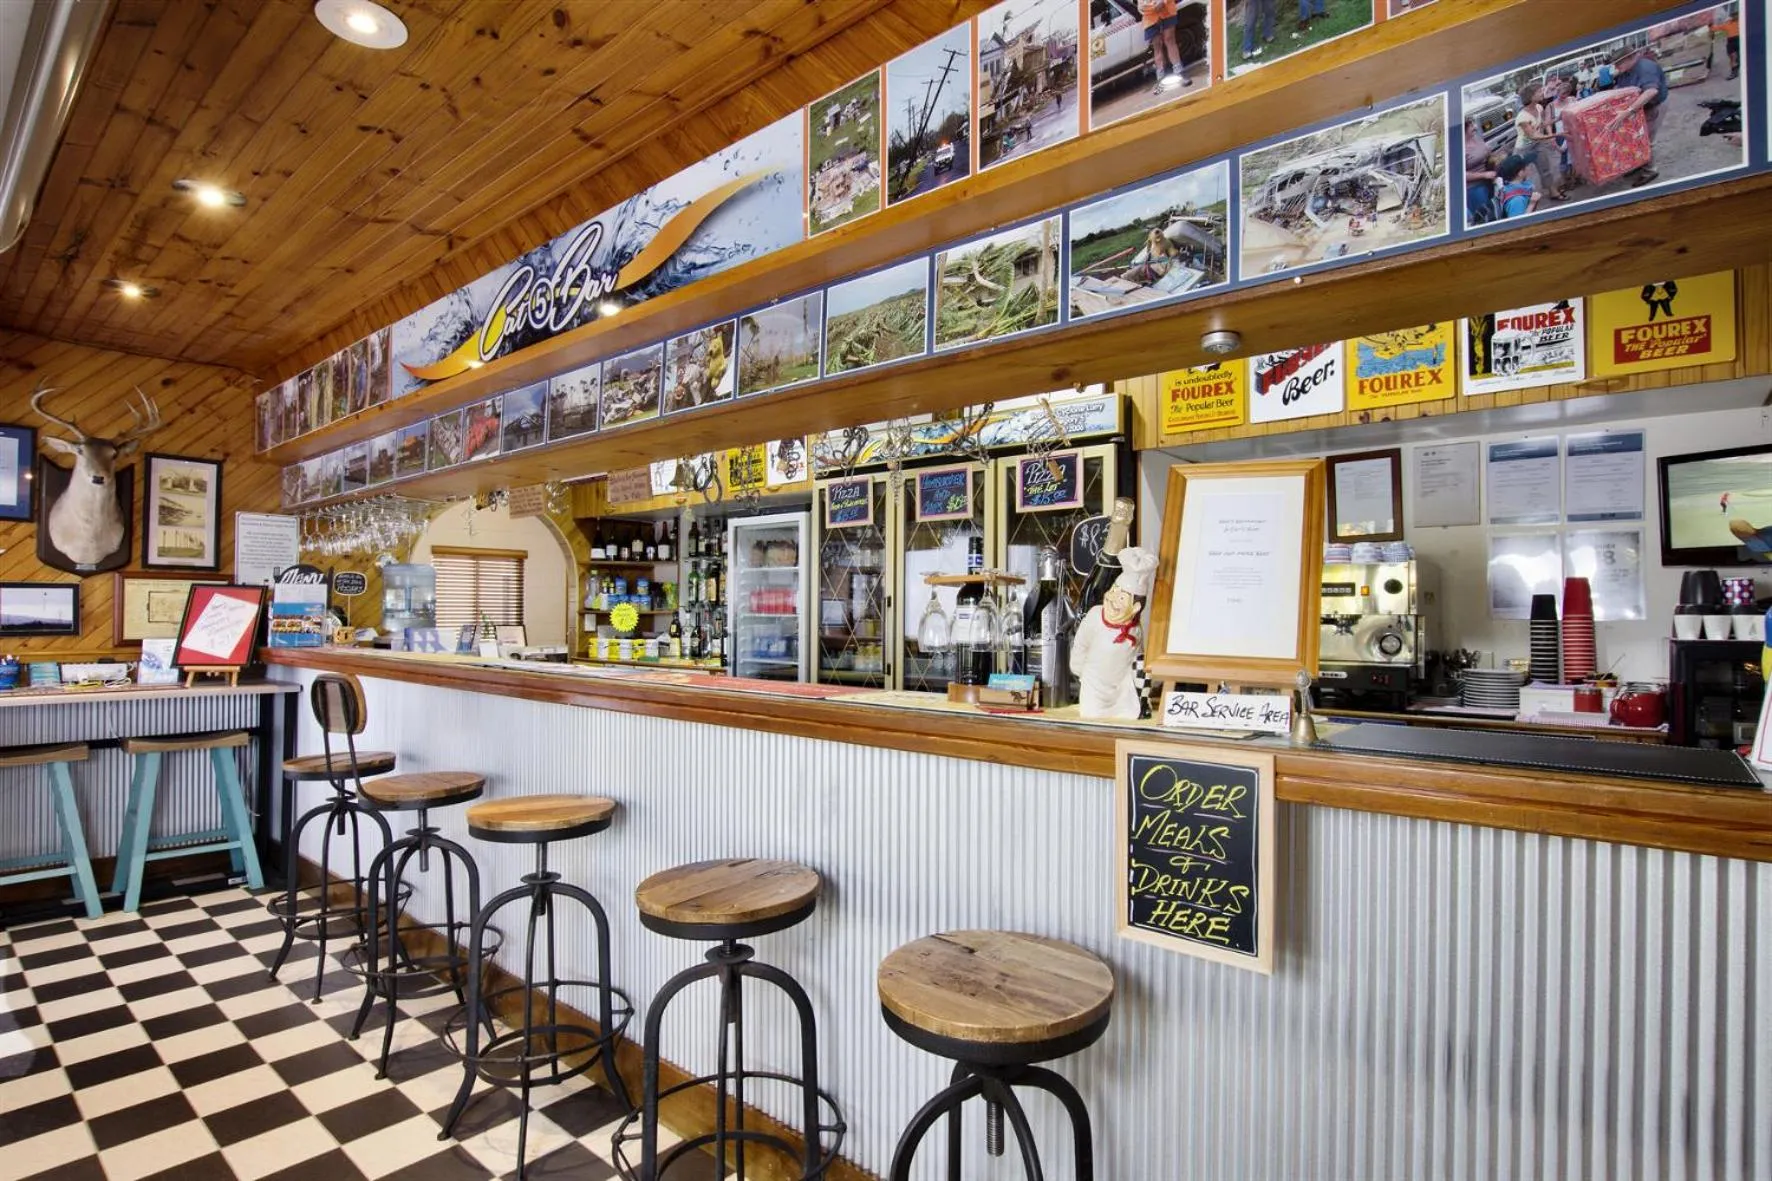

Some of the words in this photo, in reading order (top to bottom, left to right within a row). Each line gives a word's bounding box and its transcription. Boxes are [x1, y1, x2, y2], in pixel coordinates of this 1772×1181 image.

[479, 266, 534, 361] Cat
[550, 221, 619, 331] Bar
[1497, 307, 1576, 331] FOUREX
[1621, 318, 1708, 344] FOUREX
[1539, 332, 1570, 341] BEER
[1625, 343, 1647, 352] THE
[1639, 345, 1689, 359] BEER
[1171, 380, 1235, 402] FOUREX
[1183, 371, 1233, 385] undoubtedly
[1282, 358, 1335, 406] Beer.
[1358, 368, 1443, 395] FOUREX
[1186, 401, 1214, 412] Popular
[1216, 399, 1233, 408] Beer
[1167, 694, 1200, 719] BAR
[1201, 696, 1255, 720] SERVICE
[1259, 702, 1289, 725] AREA
[1140, 764, 1247, 819] ORDER
[1131, 809, 1232, 860] MEALS
[1131, 858, 1250, 914] DRINKS
[1146, 899, 1231, 944] HERE
